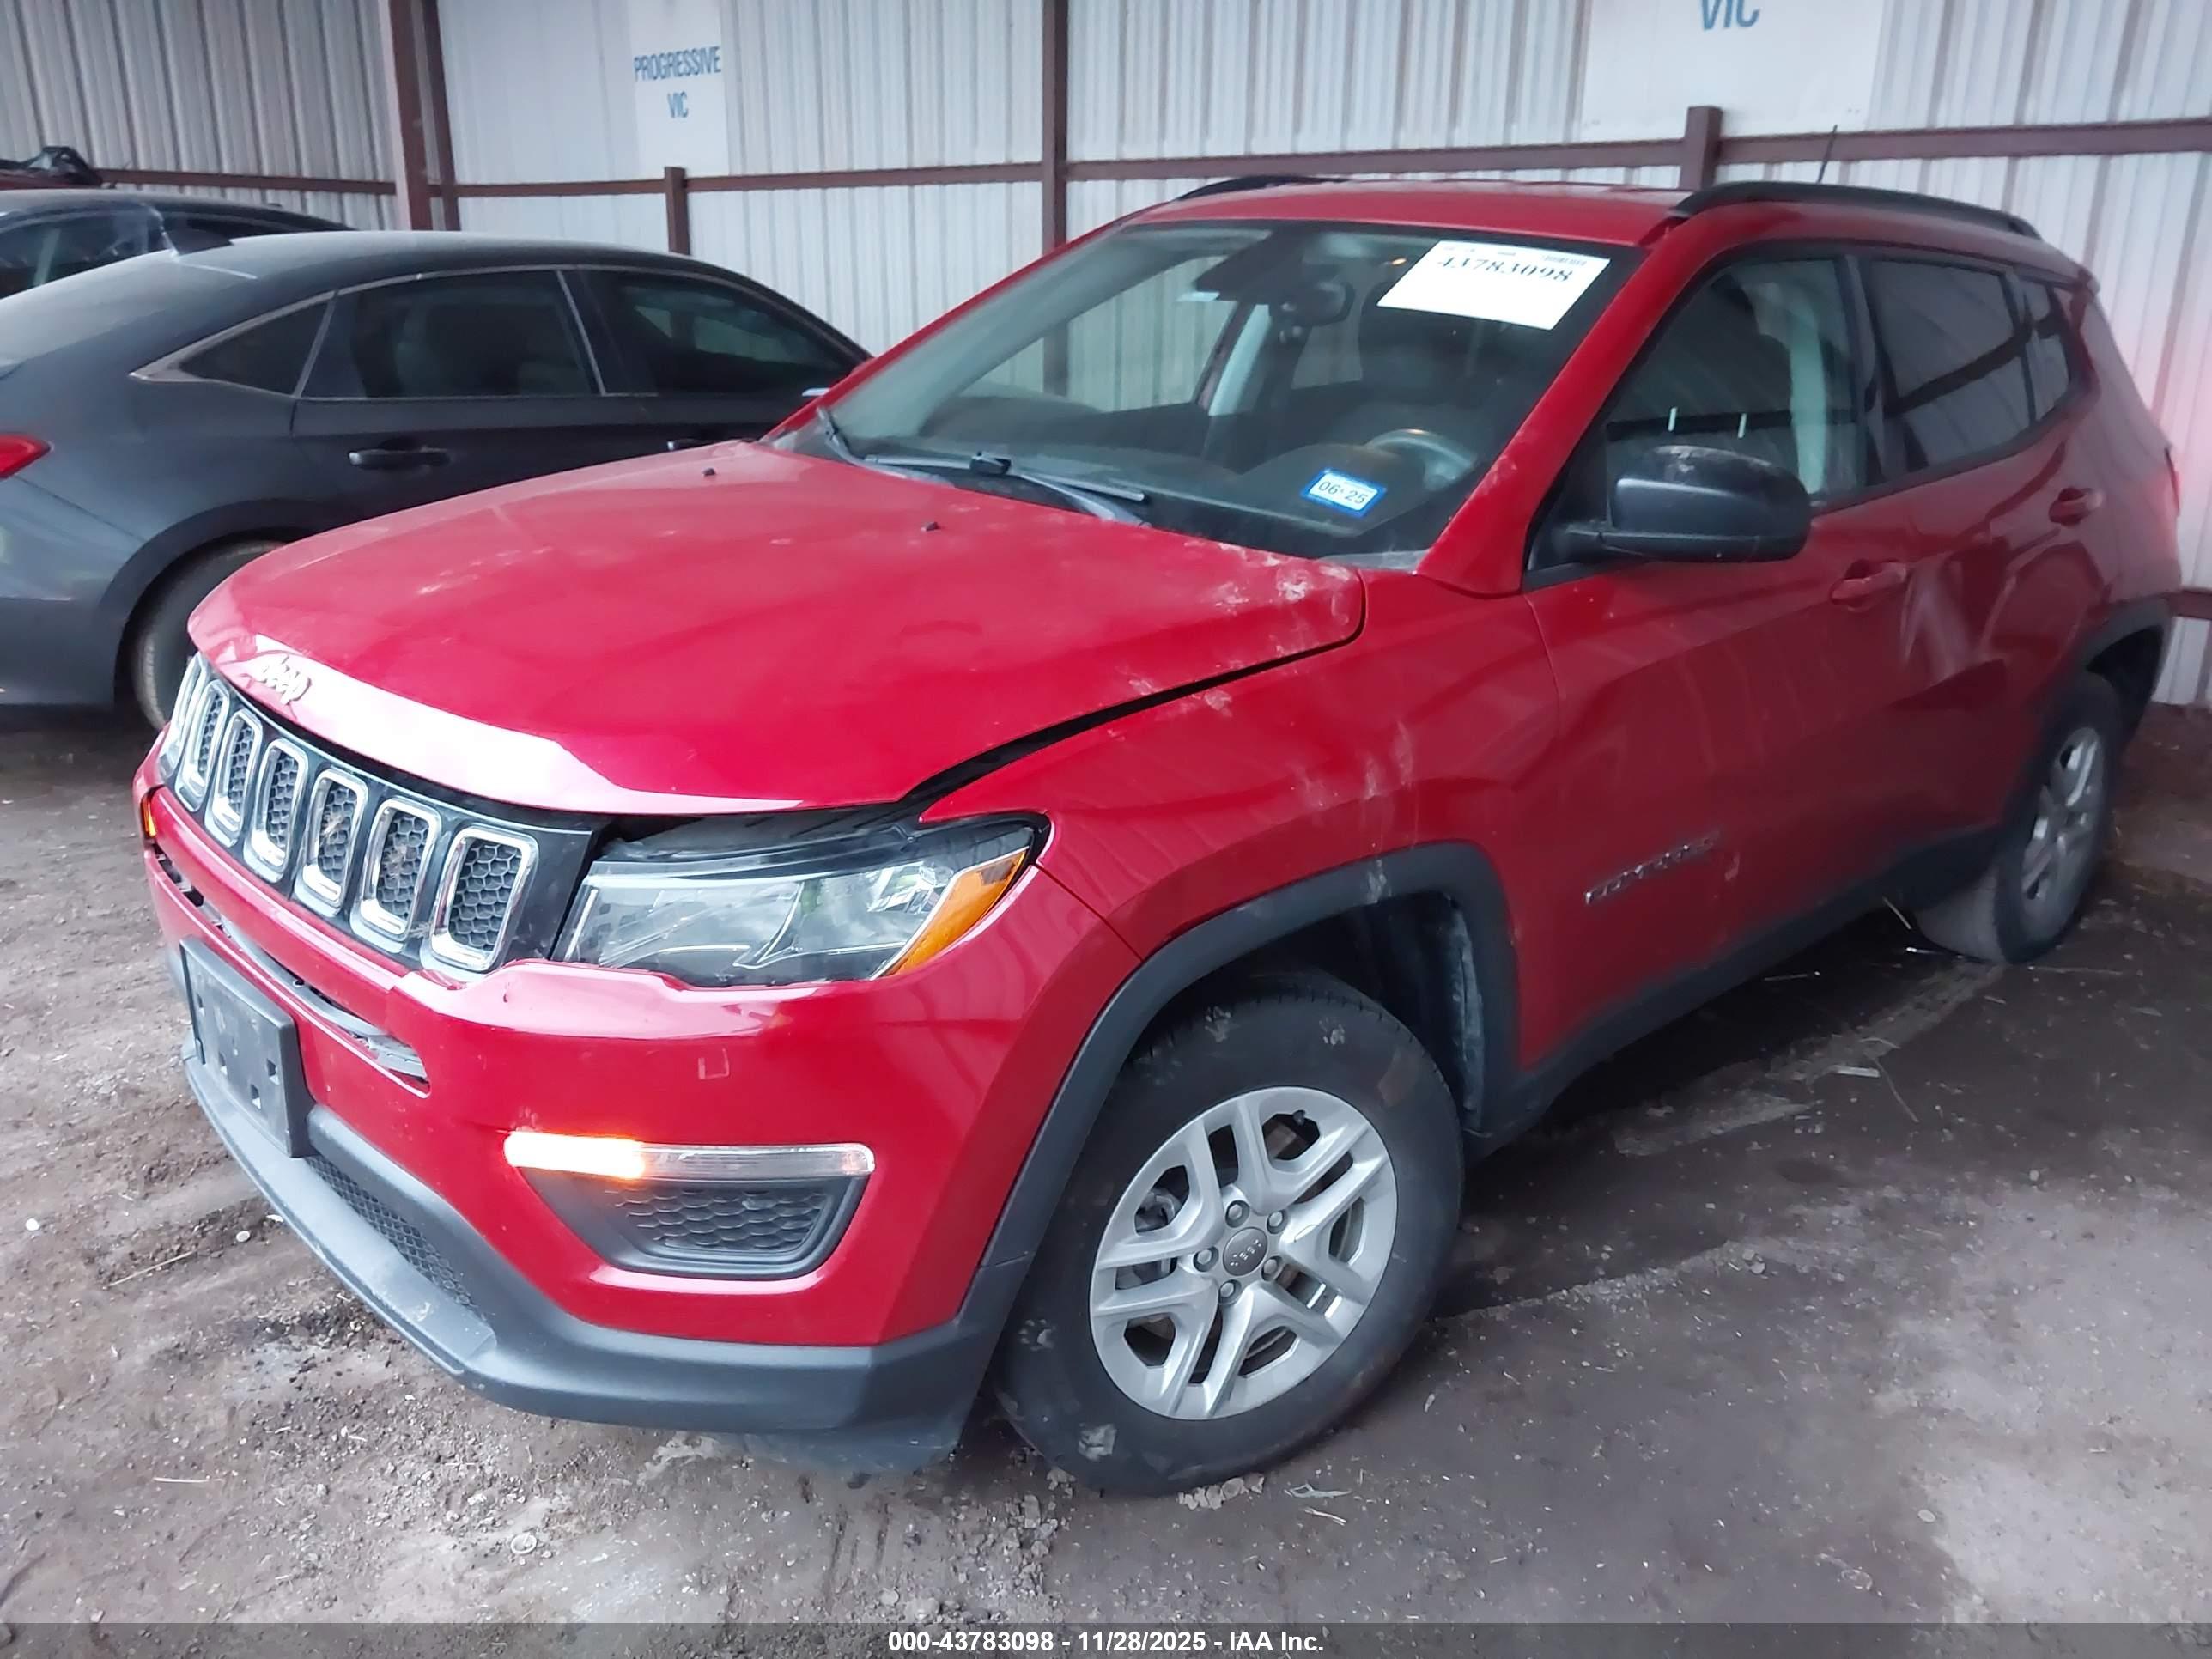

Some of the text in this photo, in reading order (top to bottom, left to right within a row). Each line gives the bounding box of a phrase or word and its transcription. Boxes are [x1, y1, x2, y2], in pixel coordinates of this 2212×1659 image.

[634, 46, 721, 82] PROGRESSIVE
[667, 91, 689, 118] VIC
[1437, 256, 1574, 282] 43783098
[1318, 480, 1369, 505] 06 25
